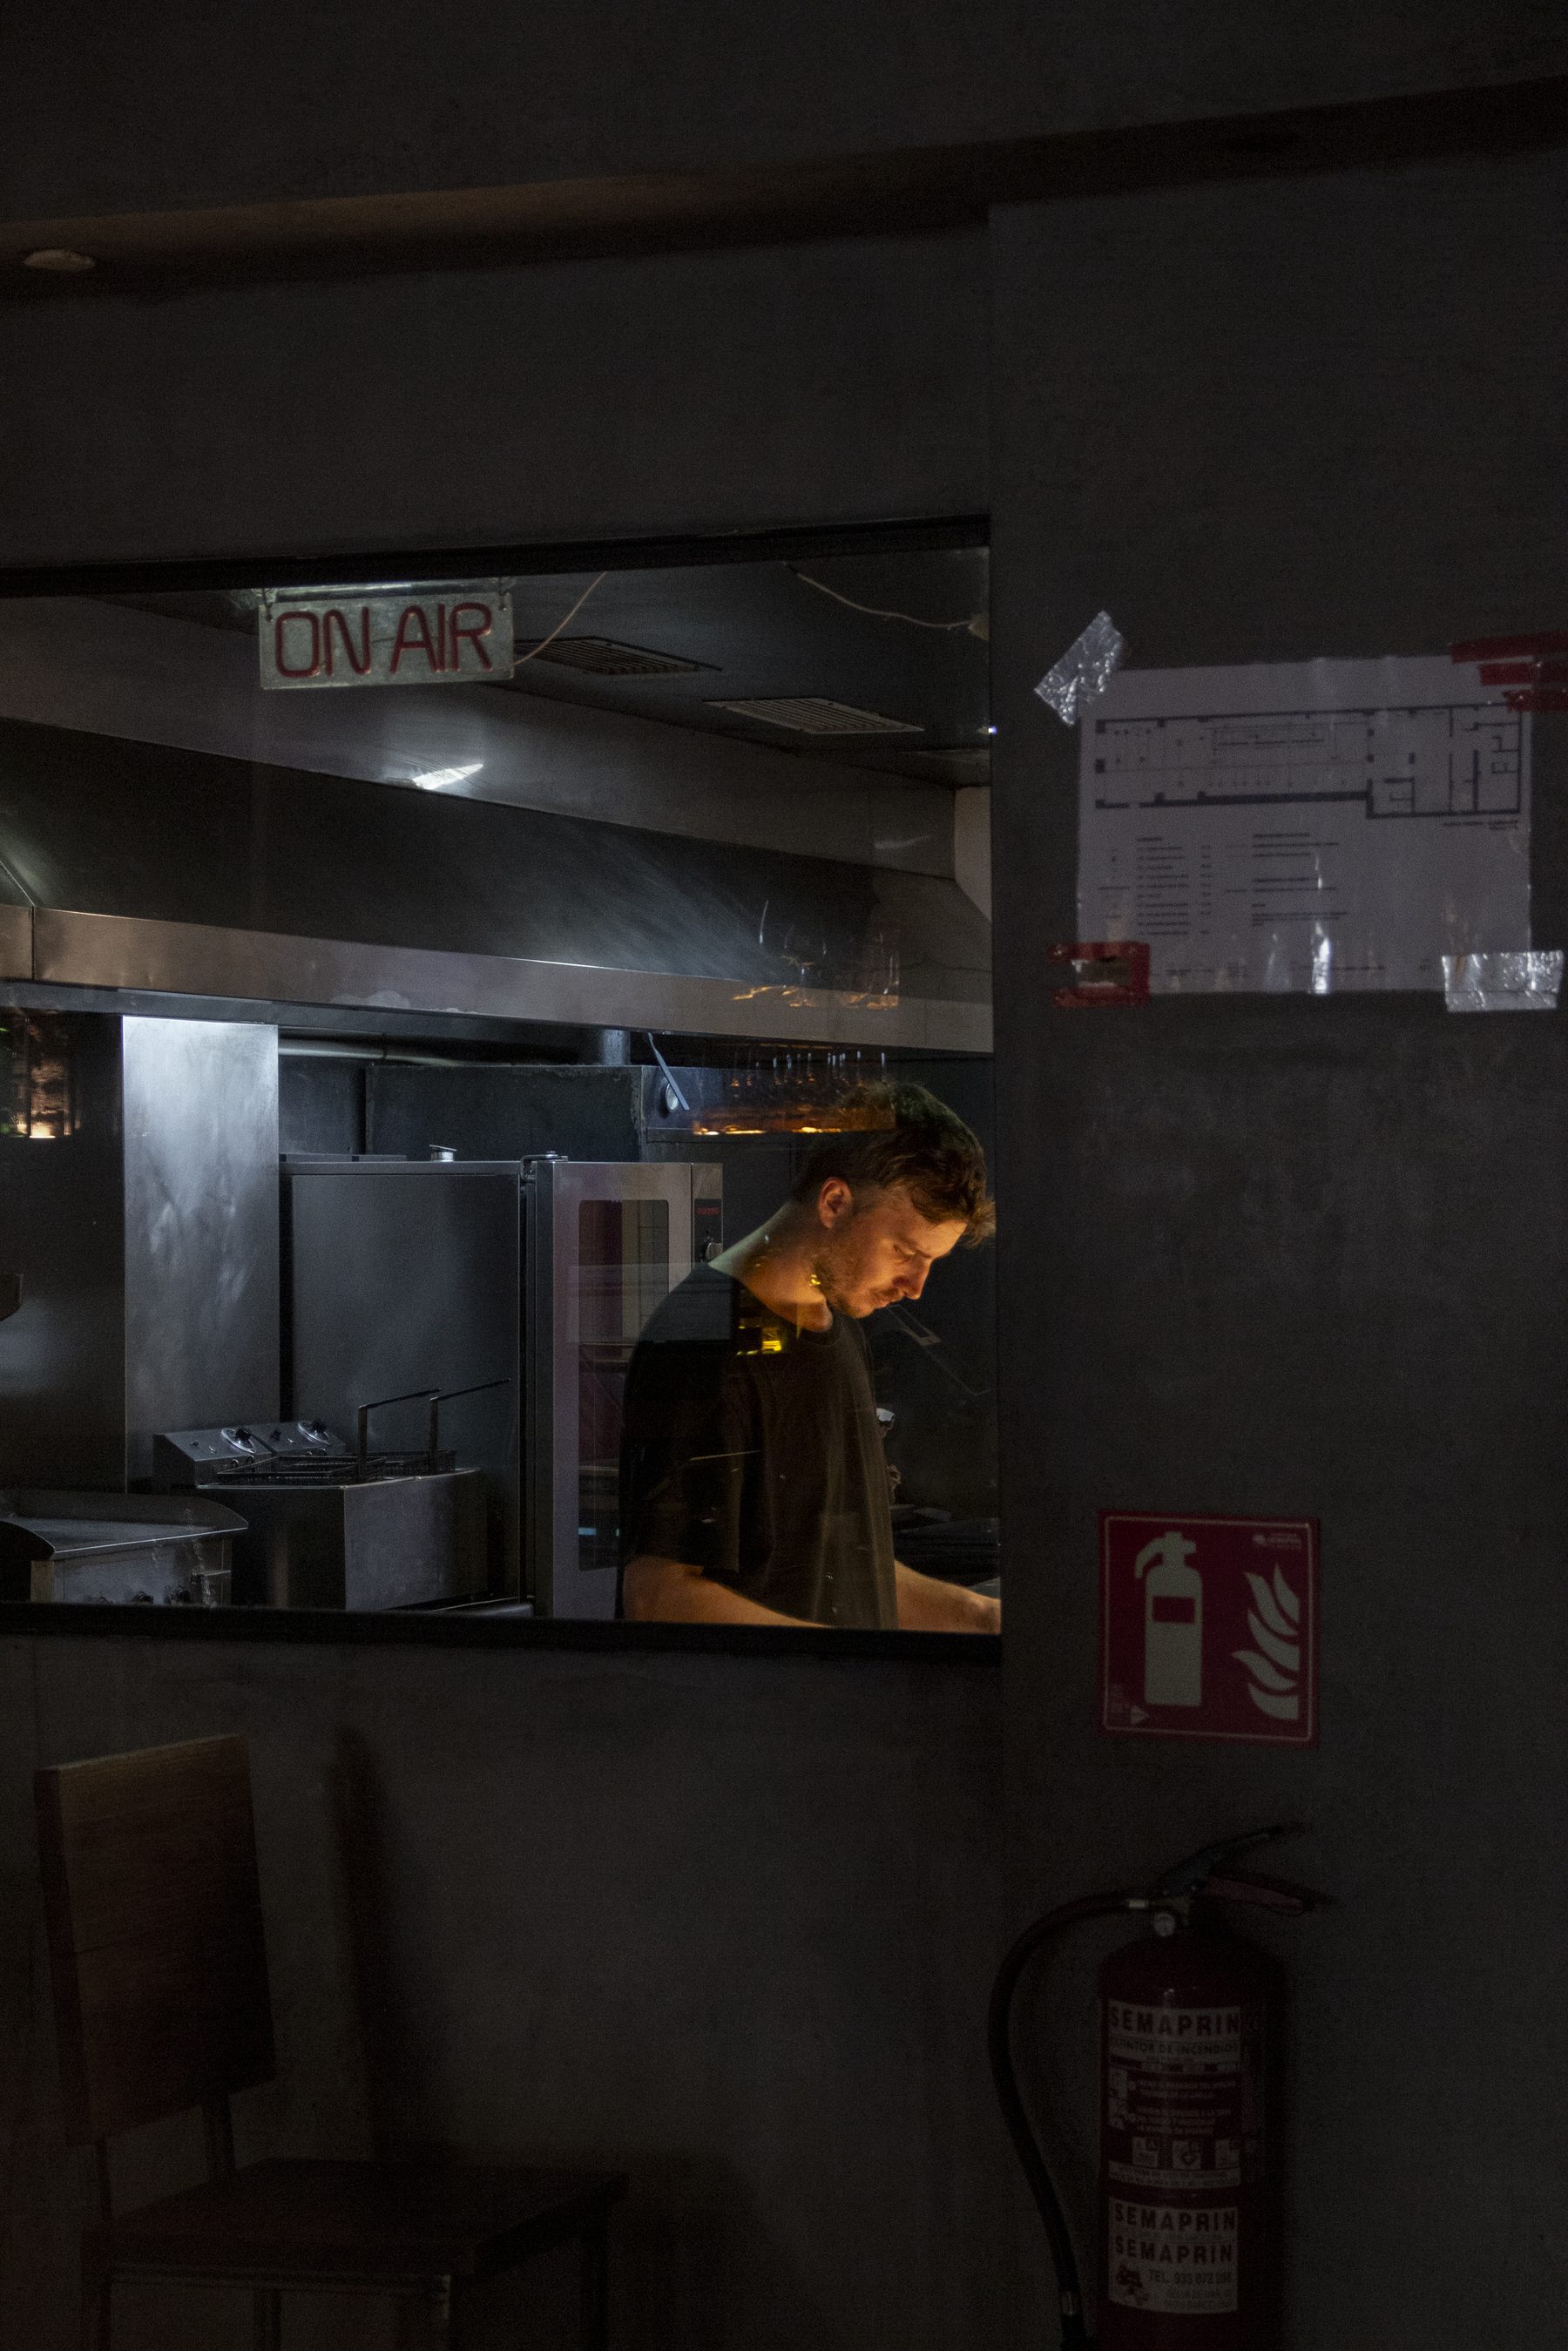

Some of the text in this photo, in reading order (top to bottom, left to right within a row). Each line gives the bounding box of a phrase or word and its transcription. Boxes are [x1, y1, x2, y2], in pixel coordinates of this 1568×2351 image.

[275, 602, 493, 678] ON AIR
[1109, 2006, 1240, 2037] SEMAPRIN
[1114, 2202, 1236, 2232] SEMAPRIN
[1114, 2234, 1233, 2265] SEMAPRIN
